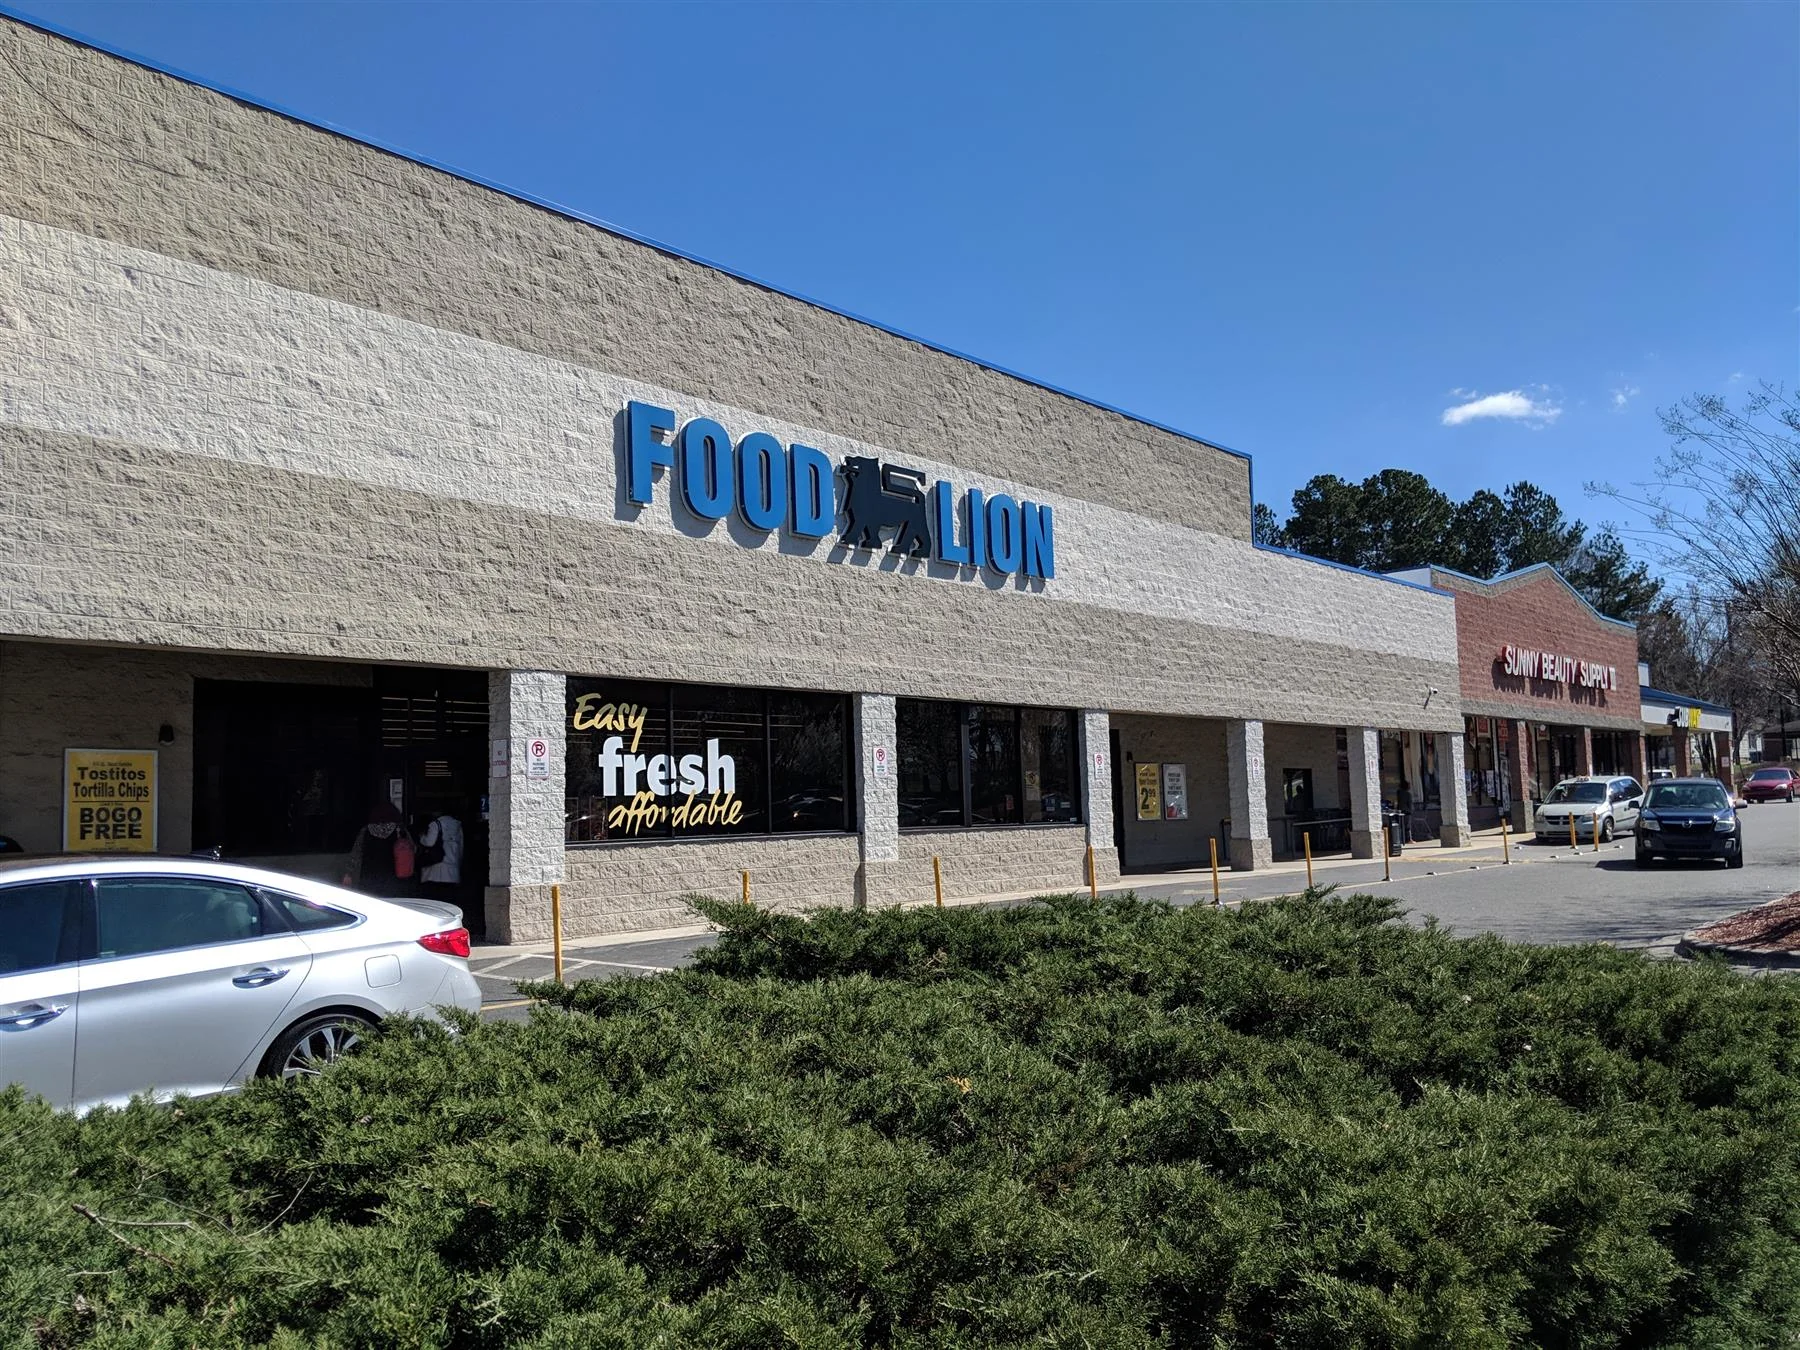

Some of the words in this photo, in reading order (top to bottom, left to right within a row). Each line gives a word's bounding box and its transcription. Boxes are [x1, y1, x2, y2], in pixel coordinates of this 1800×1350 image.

[625, 400, 835, 537] FOOD
[934, 480, 1055, 580] LION
[1502, 645, 1540, 678] SUNNY
[1541, 652, 1578, 685] BEAUTY
[1580, 660, 1609, 689] SUPPLY
[573, 693, 648, 753] Easy
[77, 766, 146, 780] Tostitos
[598, 736, 736, 797] fresh
[73, 782, 115, 798] Tortilla
[118, 781, 150, 801] Chips
[1140, 787, 1150, 810] 2
[79, 806, 143, 824] BOGO
[608, 789, 744, 837] affordable
[79, 823, 143, 841] FREE
